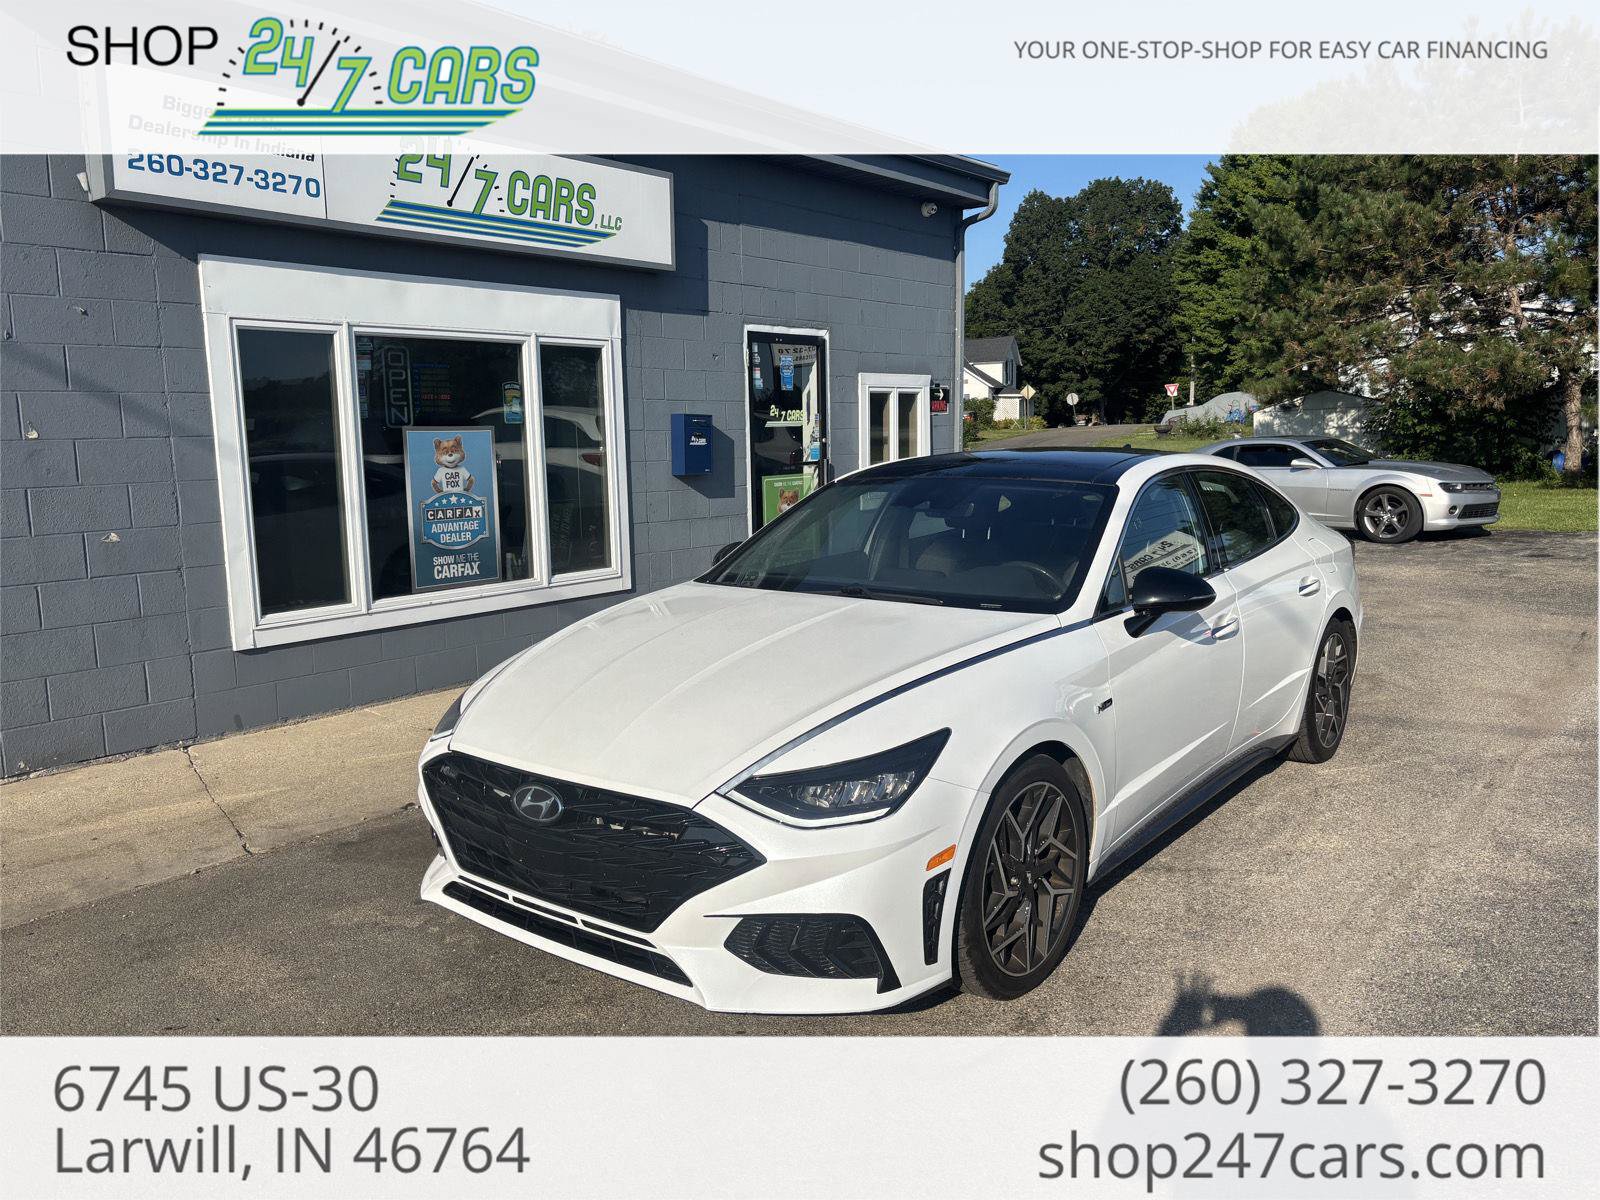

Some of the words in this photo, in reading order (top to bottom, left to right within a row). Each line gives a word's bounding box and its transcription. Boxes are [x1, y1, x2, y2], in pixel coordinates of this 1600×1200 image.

[127, 148, 321, 198] 260-327-3270
[507, 170, 597, 226] CARS
[387, 350, 410, 425] OPEN
[445, 472, 460, 480] CAR
[446, 480, 460, 488] FOX
[426, 506, 482, 521] CARFAX
[431, 521, 479, 533] ADVANTAGE
[440, 531, 472, 543] DEALER
[433, 555, 454, 566] SHOW
[456, 554, 466, 563] ME
[467, 552, 479, 561] THE
[434, 562, 480, 580] CARFAX
